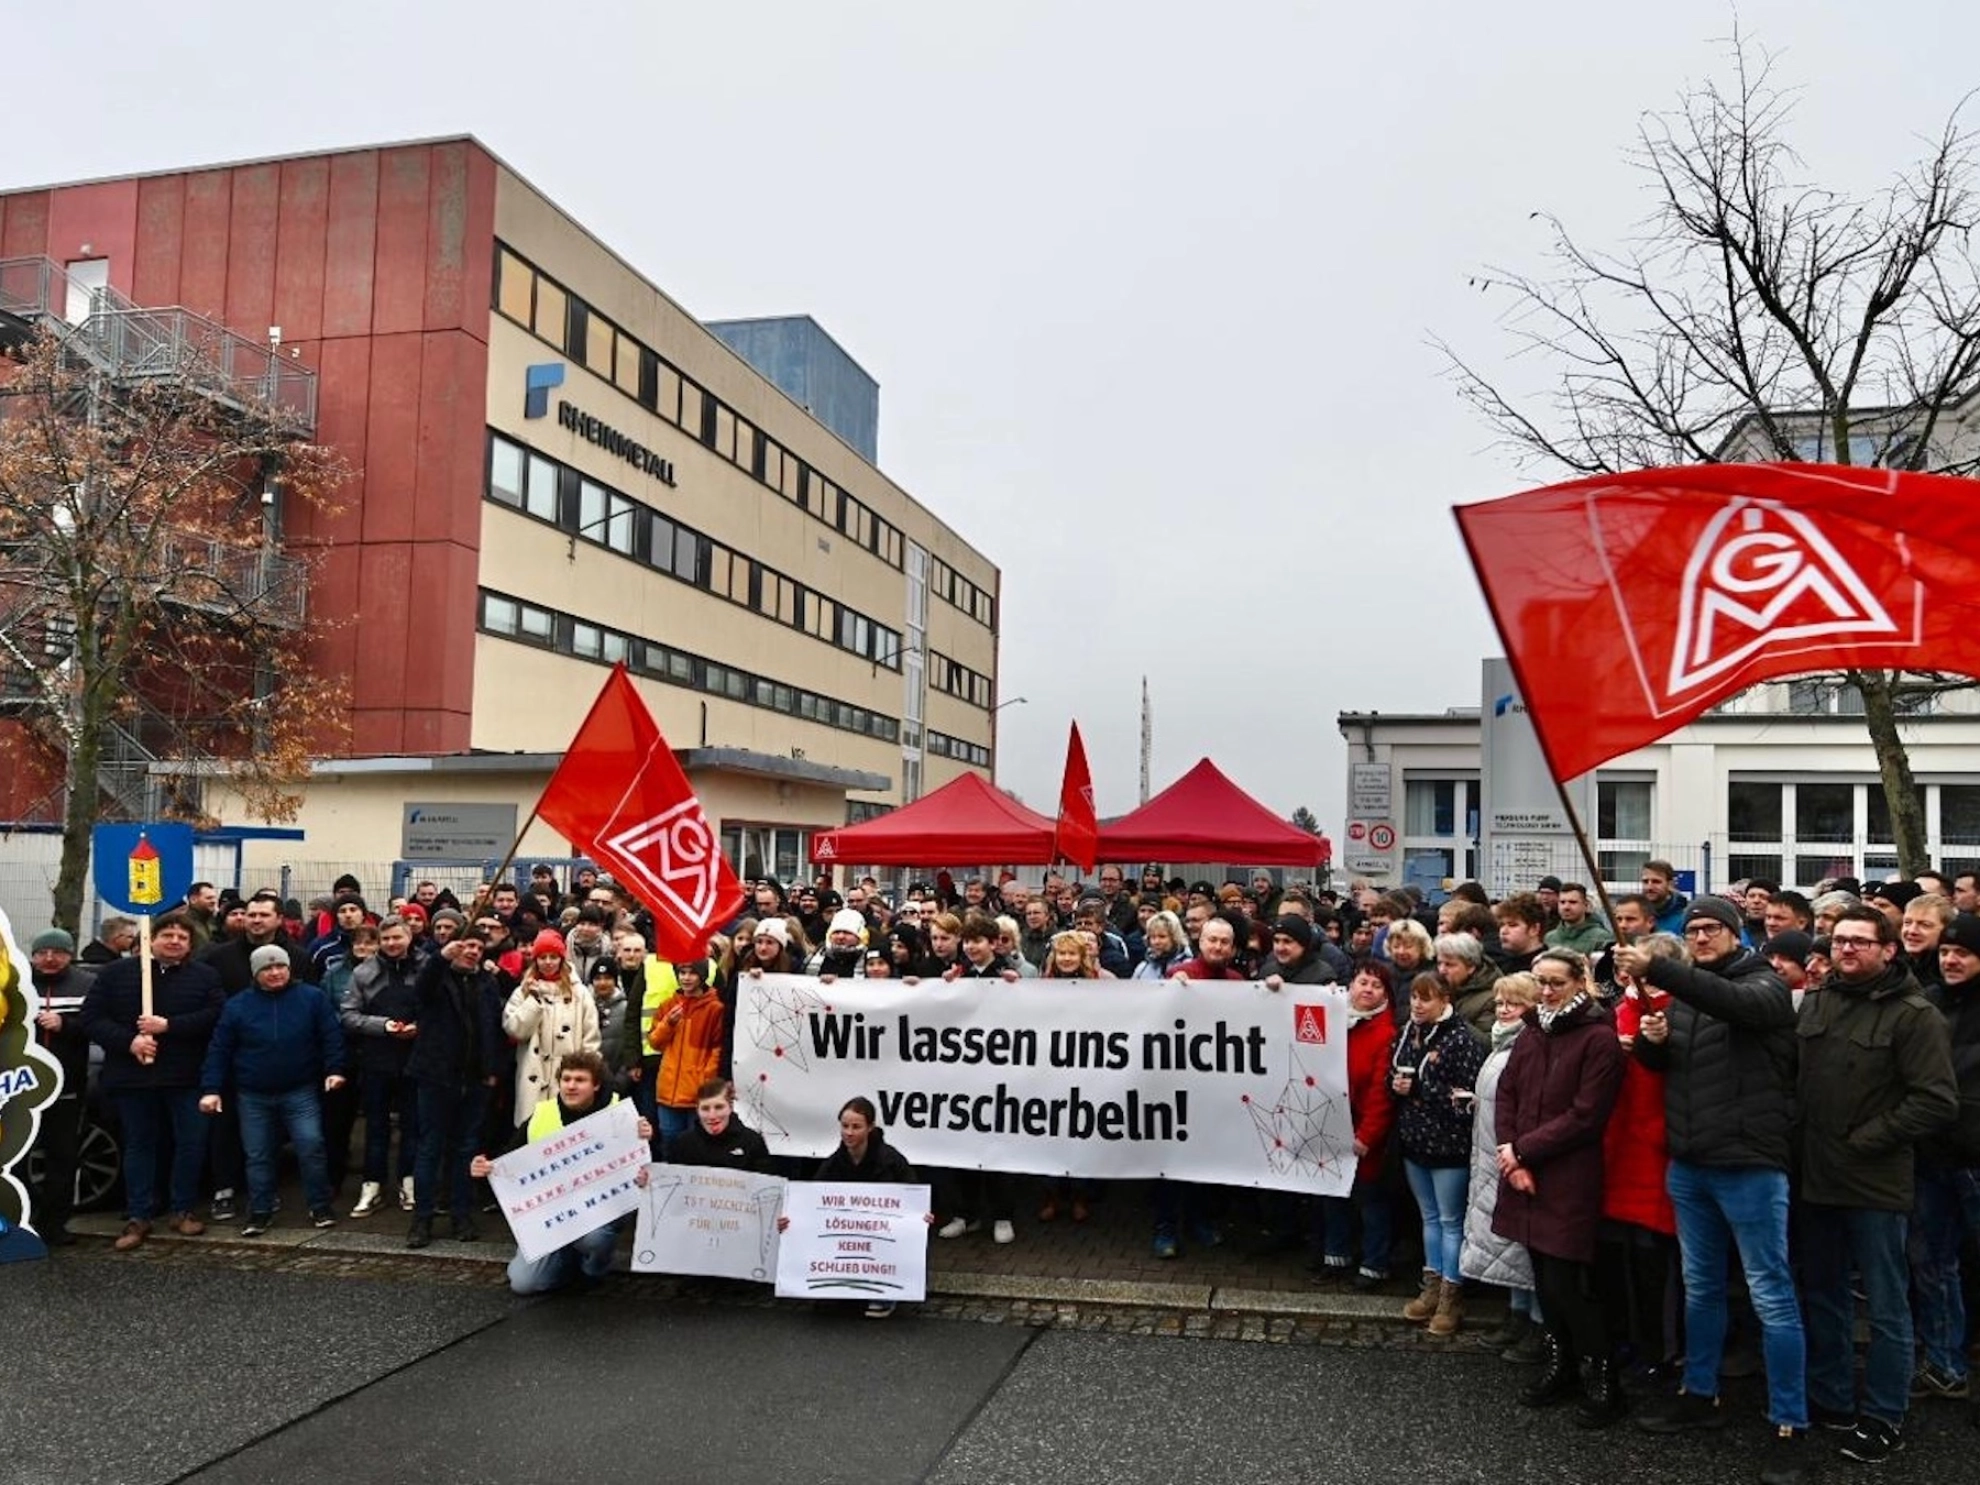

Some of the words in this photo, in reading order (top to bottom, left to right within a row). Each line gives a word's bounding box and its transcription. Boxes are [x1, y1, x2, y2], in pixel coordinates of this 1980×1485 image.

[558, 400, 677, 488] RHEINMETALL
[1376, 831, 1389, 844] 10
[810, 1012, 885, 1060] Wir
[898, 1014, 1037, 1067] lassen
[1049, 1028, 1130, 1070] uns
[1142, 1019, 1267, 1075] nicht
[878, 1084, 1189, 1142] verscherbeln!
[543, 1129, 592, 1156] OHNE
[511, 1184, 566, 1214] KEINE
[822, 1196, 845, 1206] WIR
[850, 1196, 901, 1209] WOLLEN
[544, 1209, 578, 1229] FÜR
[838, 1242, 872, 1251] KEINE
